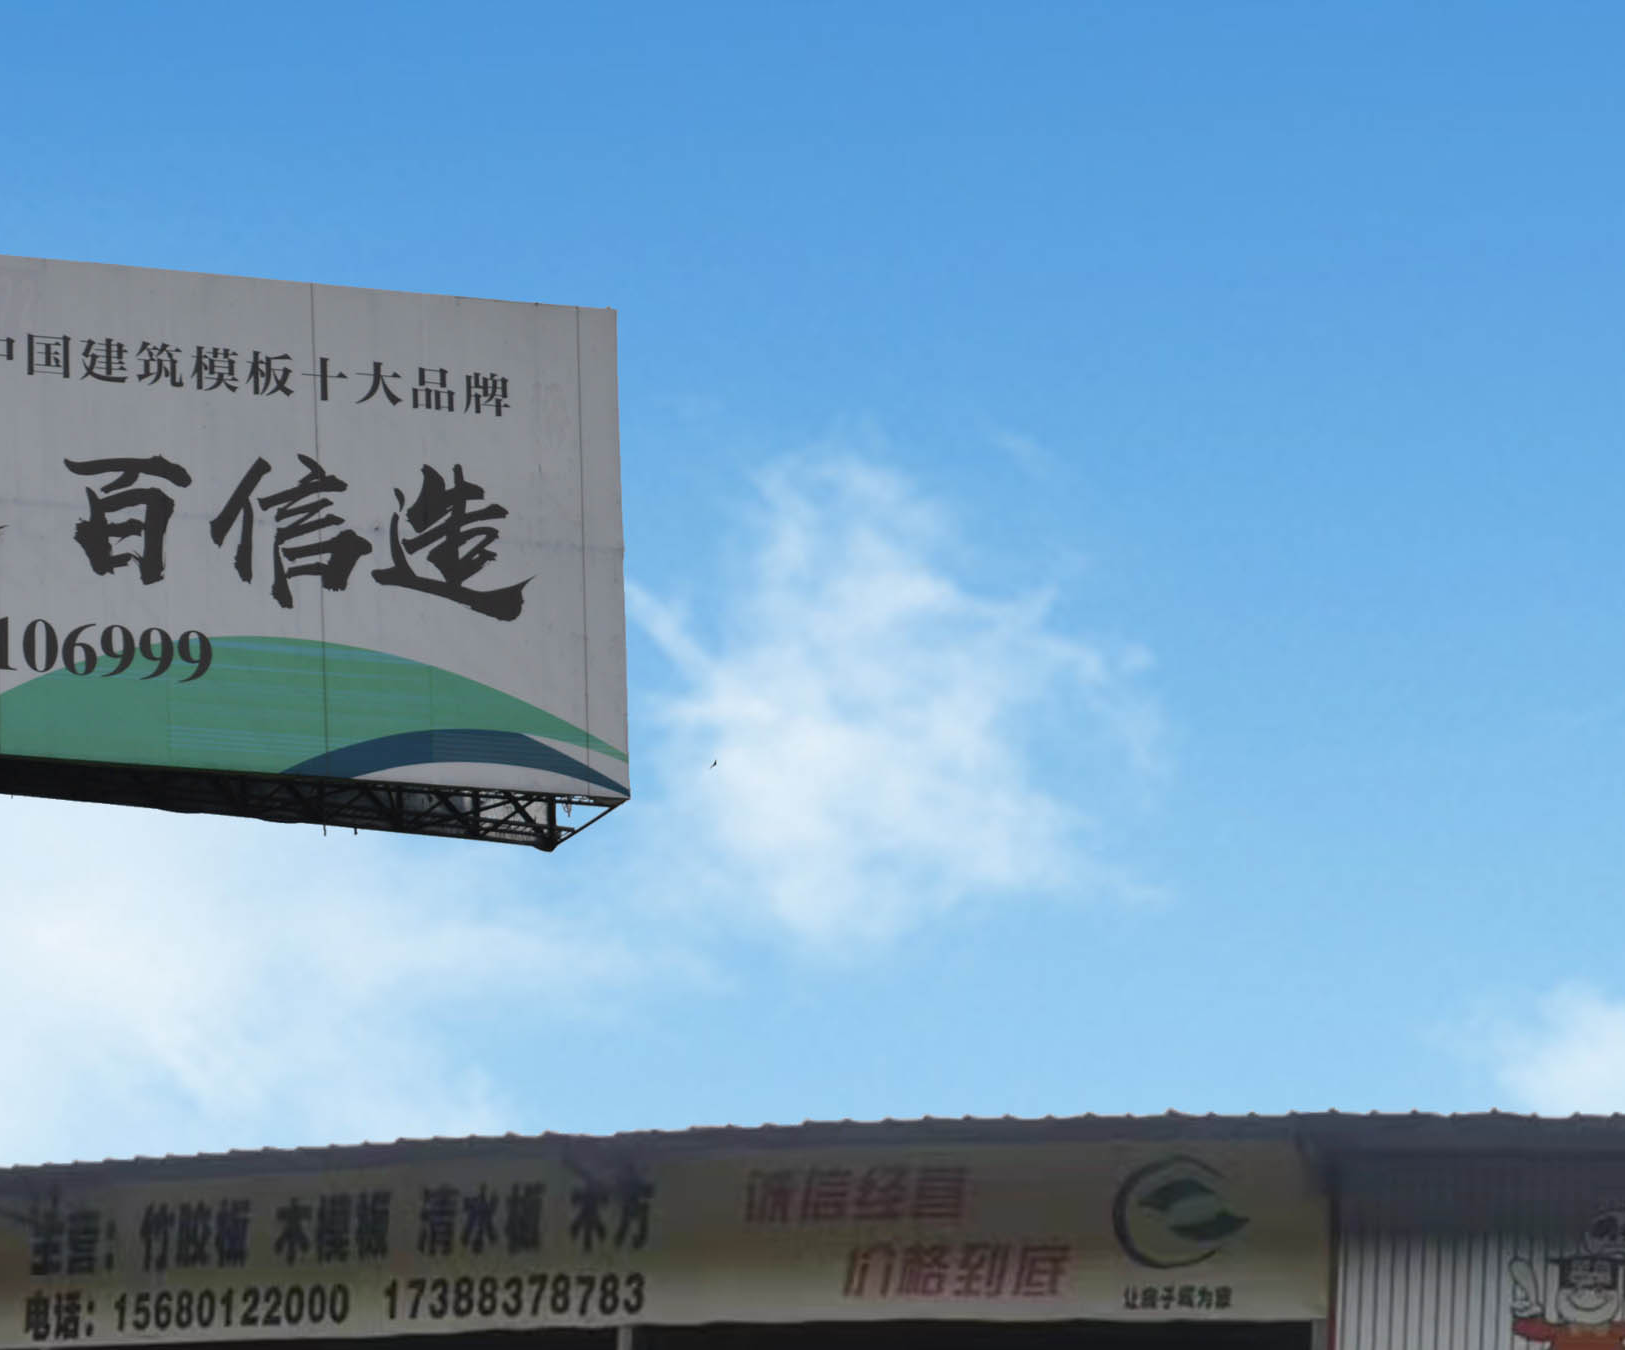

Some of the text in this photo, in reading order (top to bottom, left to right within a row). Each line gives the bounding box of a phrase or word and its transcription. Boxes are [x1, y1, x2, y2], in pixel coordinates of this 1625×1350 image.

[64, 453, 537, 623] 百信造
[842, 1240, 1078, 1299] 价格到底
[113, 1282, 351, 1333] 15680122000
[383, 1272, 647, 1322] 17388378783
